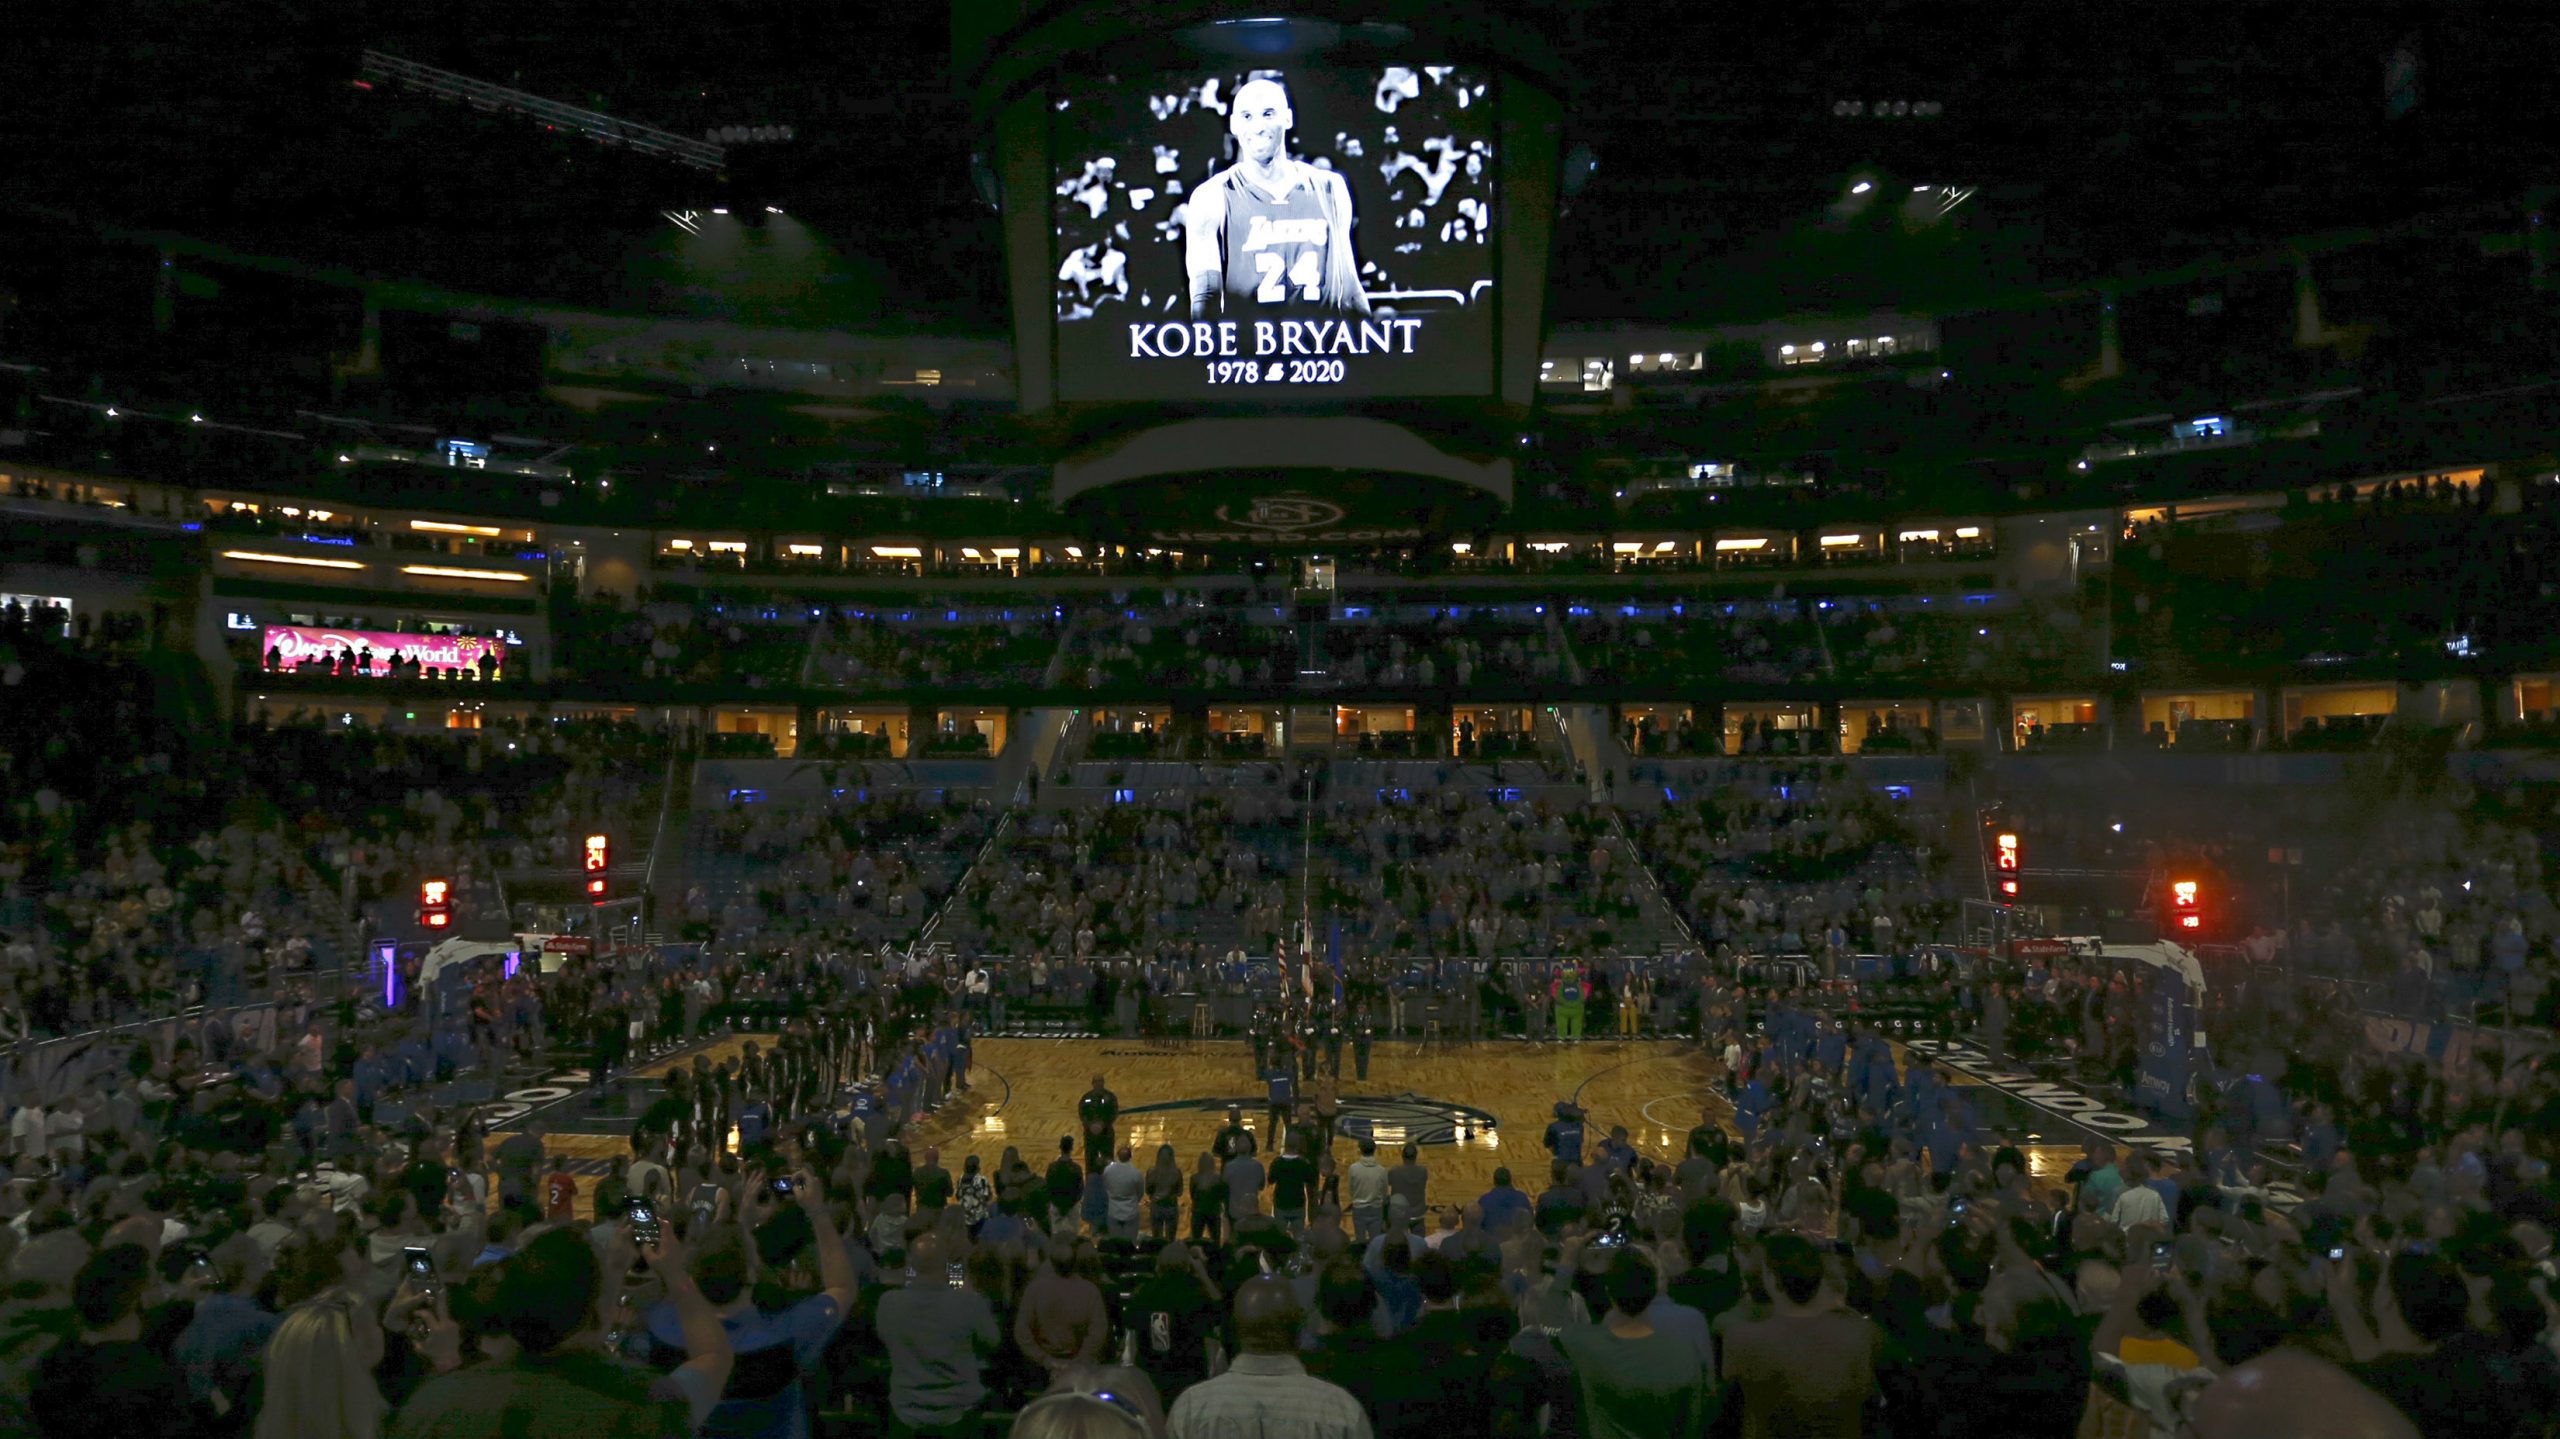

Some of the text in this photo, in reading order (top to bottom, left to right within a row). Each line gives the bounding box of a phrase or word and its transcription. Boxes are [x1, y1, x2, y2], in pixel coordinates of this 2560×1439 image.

[1254, 251, 1321, 303] 24
[1129, 319, 1422, 358] KOBE BRYANT
[1207, 360, 1345, 384] 1978 2020
[404, 644, 460, 664] World
